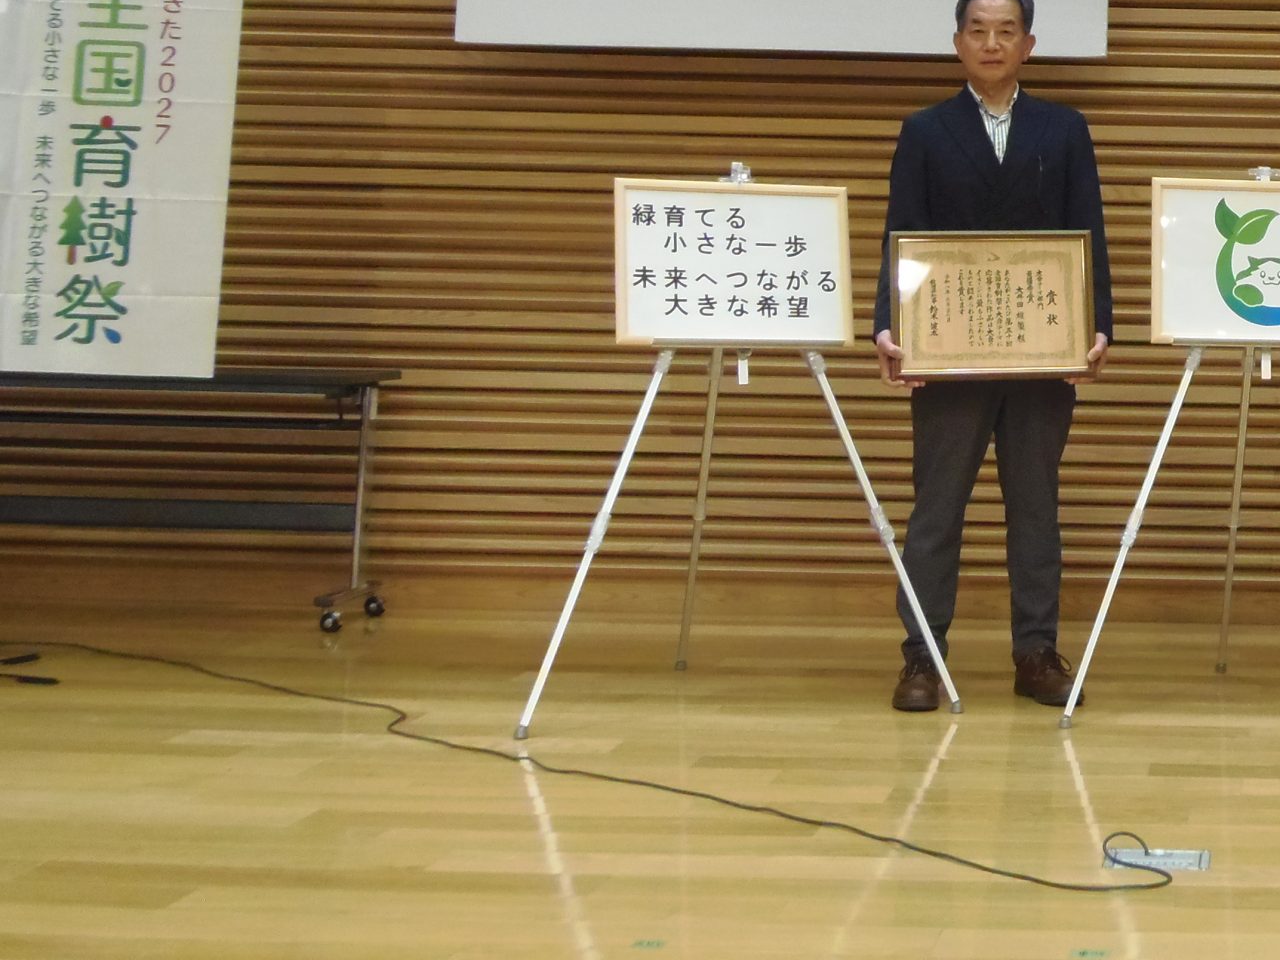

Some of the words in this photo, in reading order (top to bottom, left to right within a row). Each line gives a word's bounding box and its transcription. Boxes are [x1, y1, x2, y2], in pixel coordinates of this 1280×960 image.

[632, 203, 746, 229] 緑育てる
[664, 232, 807, 258] 小さな一歩
[633, 266, 837, 293] 未来へつながる
[664, 294, 810, 319] 大きな希望
